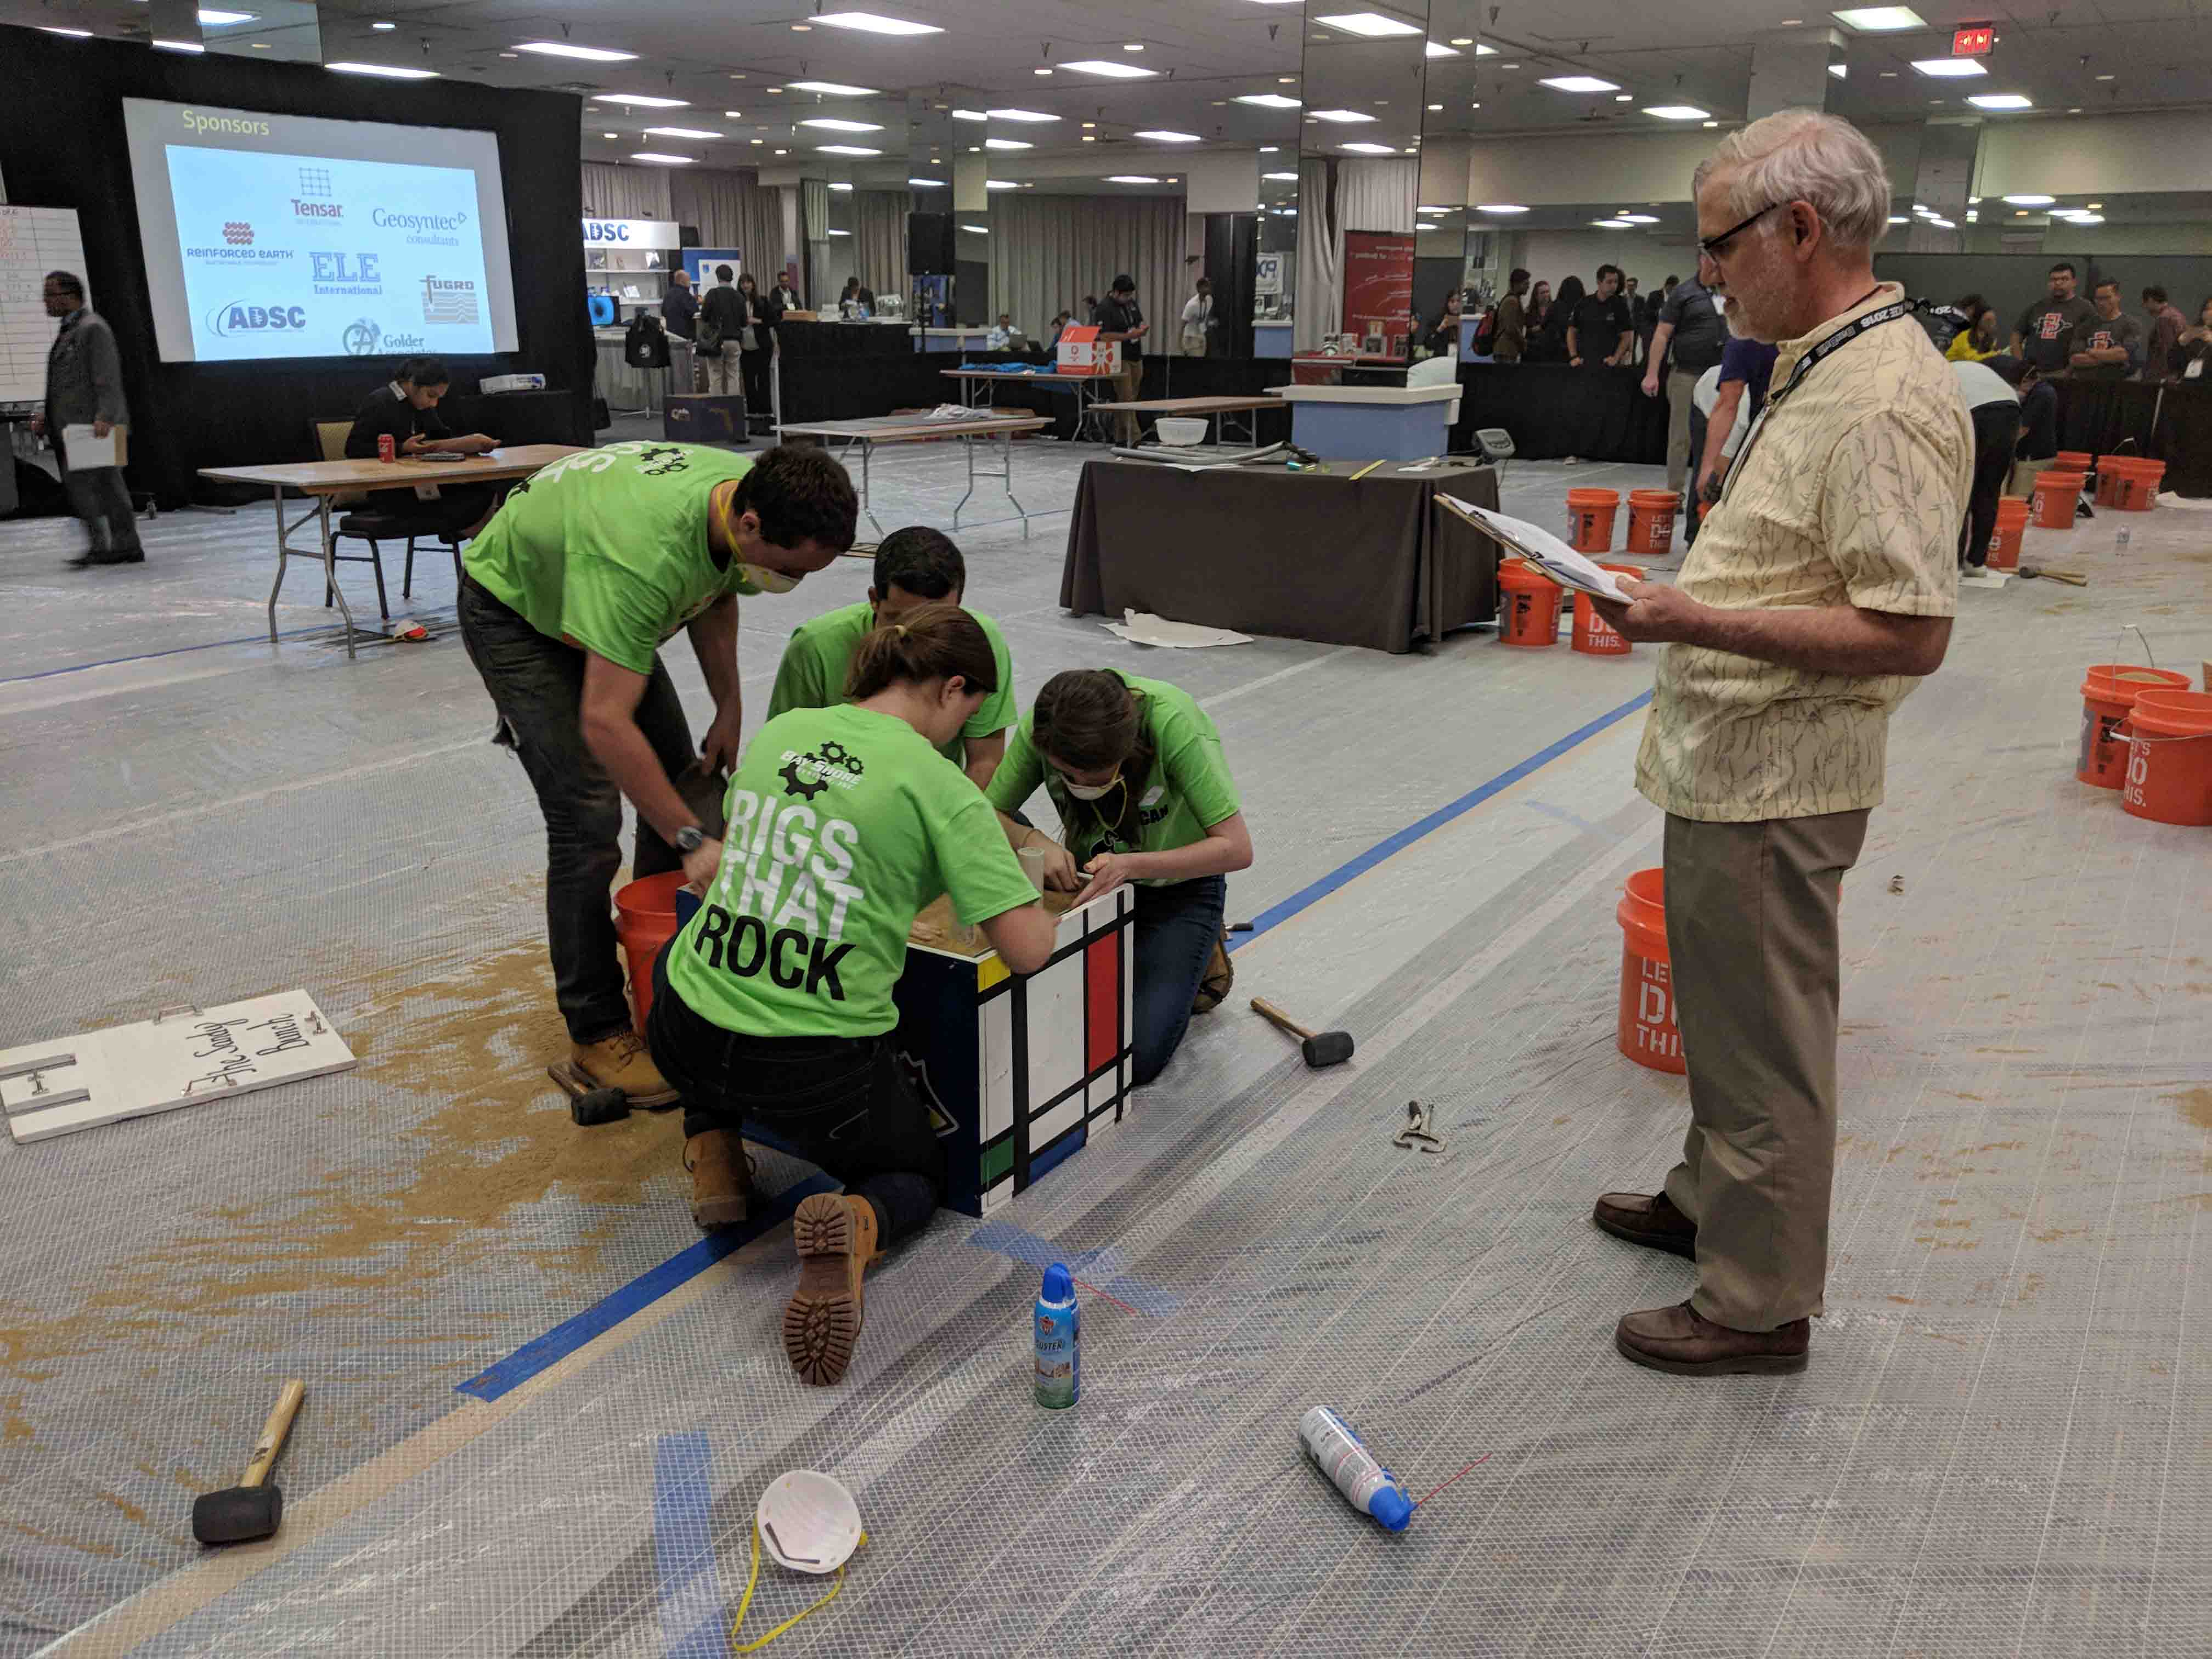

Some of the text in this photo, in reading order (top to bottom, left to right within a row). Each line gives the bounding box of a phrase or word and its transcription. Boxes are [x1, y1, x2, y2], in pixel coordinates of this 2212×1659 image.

[183, 110, 269, 136] Sponsors
[291, 199, 342, 218] Tensar
[373, 208, 458, 233] Geosyntec
[309, 252, 381, 282] ELE
[314, 284, 382, 295] International
[228, 306, 306, 329] ADSC
[1929, 306, 1951, 315] 201
[383, 333, 425, 347] Golder
[729, 789, 859, 881] RIGS
[719, 846, 865, 941] THAT
[695, 904, 857, 1001] ROCK
[1641, 956, 1669, 983] LE
[1638, 980, 1678, 1028] D
[185, 1018, 250, 1058] Sandy
[246, 1013, 312, 1056] Bunch
[1636, 1022, 1686, 1058] THI
